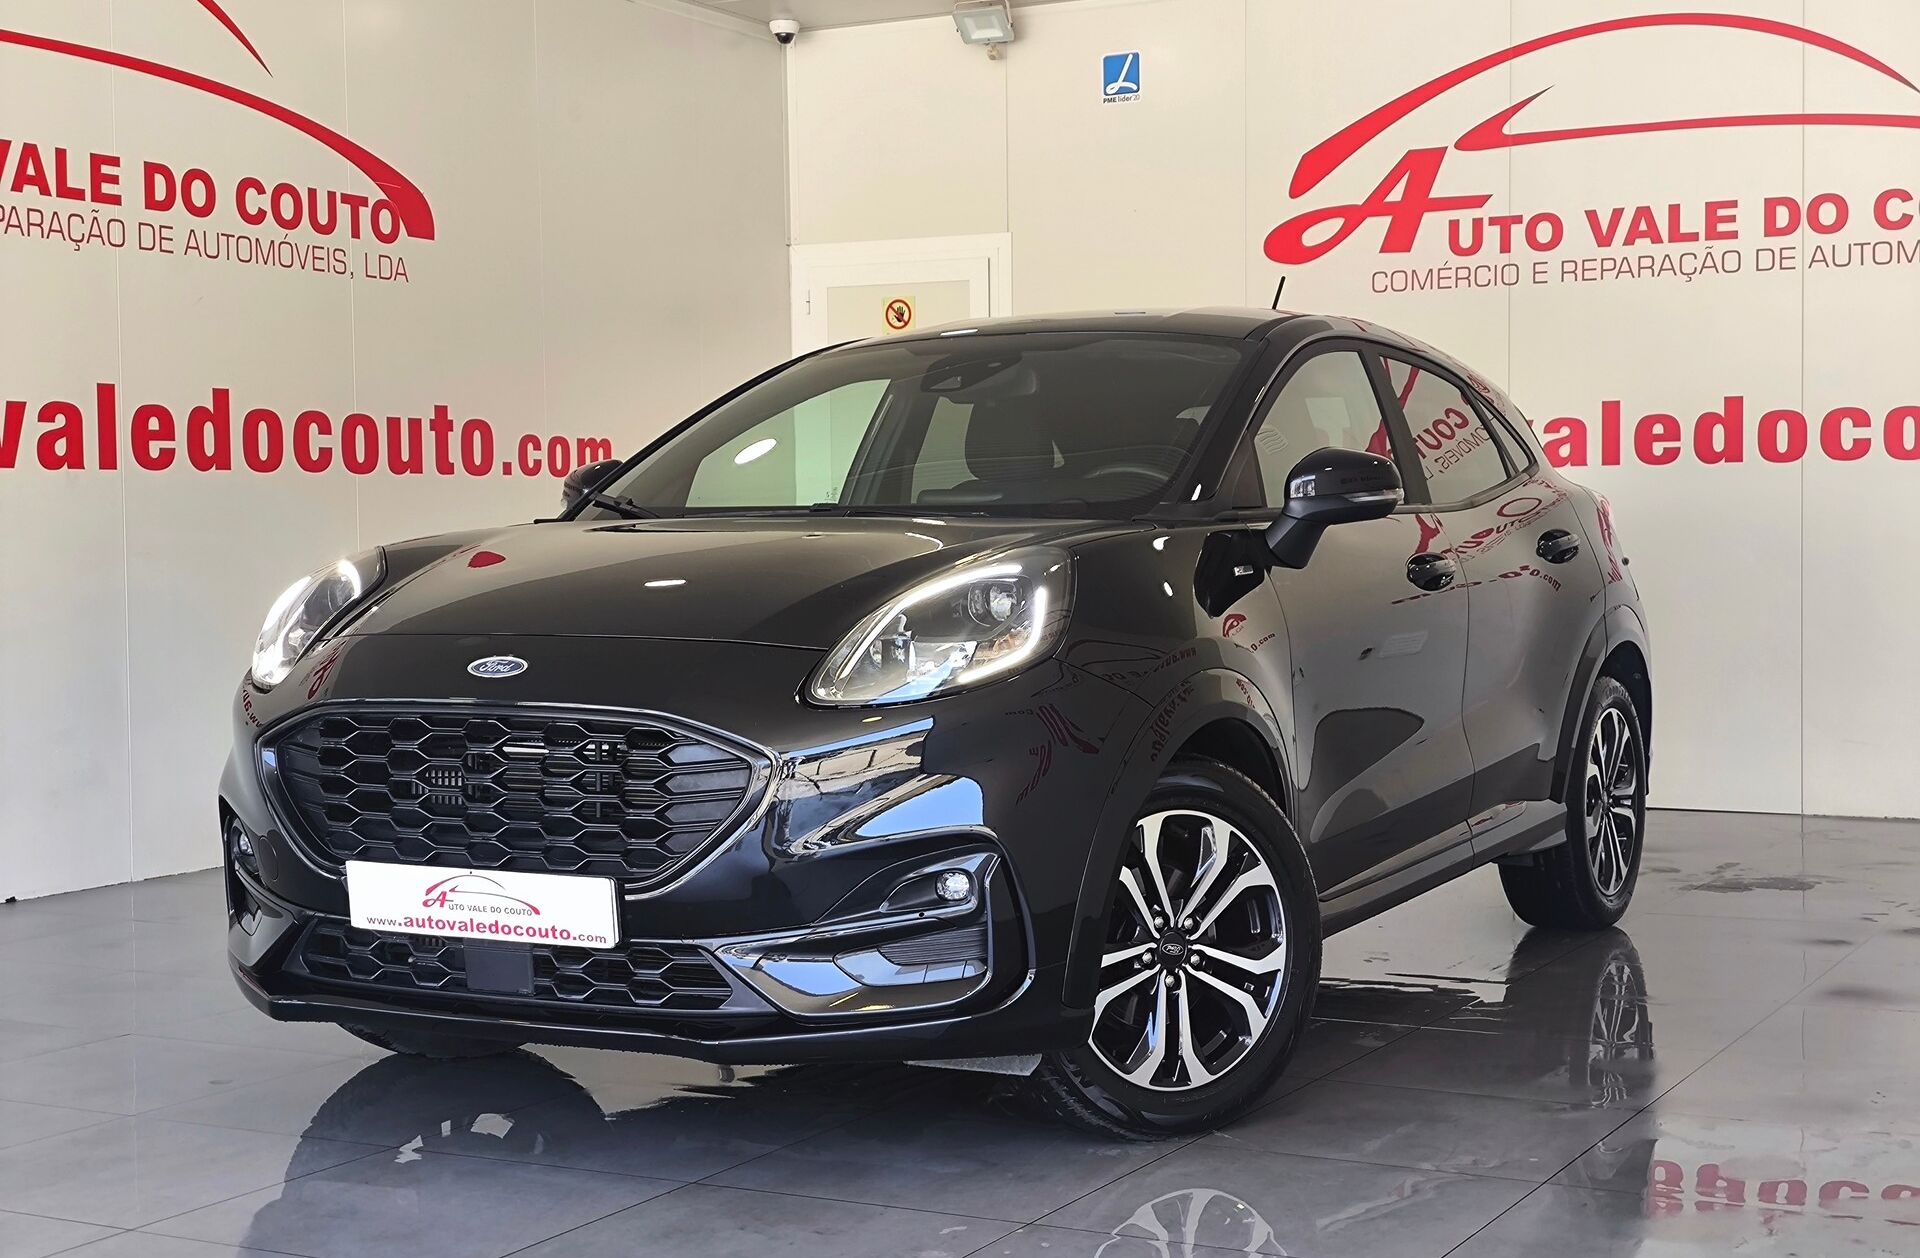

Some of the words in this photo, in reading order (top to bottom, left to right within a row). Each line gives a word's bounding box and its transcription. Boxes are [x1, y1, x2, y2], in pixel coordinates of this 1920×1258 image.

[0, 138, 123, 207] ALE
[143, 160, 217, 219] DO
[235, 176, 401, 245] COUTO
[1584, 199, 1739, 248] VALE
[1763, 192, 1850, 238] DO
[138, 221, 174, 255] DE
[184, 227, 355, 280] AUTOMÓVEIS,
[364, 251, 410, 283] LDA
[1371, 260, 1520, 294] COMÉRCIO
[1532, 261, 1549, 285] E
[1560, 245, 1742, 283] REPARAÇÃO
[1755, 246, 1797, 272] DE
[1527, 395, 1920, 468] aledoco
[366, 914, 608, 945] www.autovaledocouto.com
[466, 904, 488, 914] VALE
[490, 906, 502, 914] DO
[504, 907, 533, 917] COUTO
